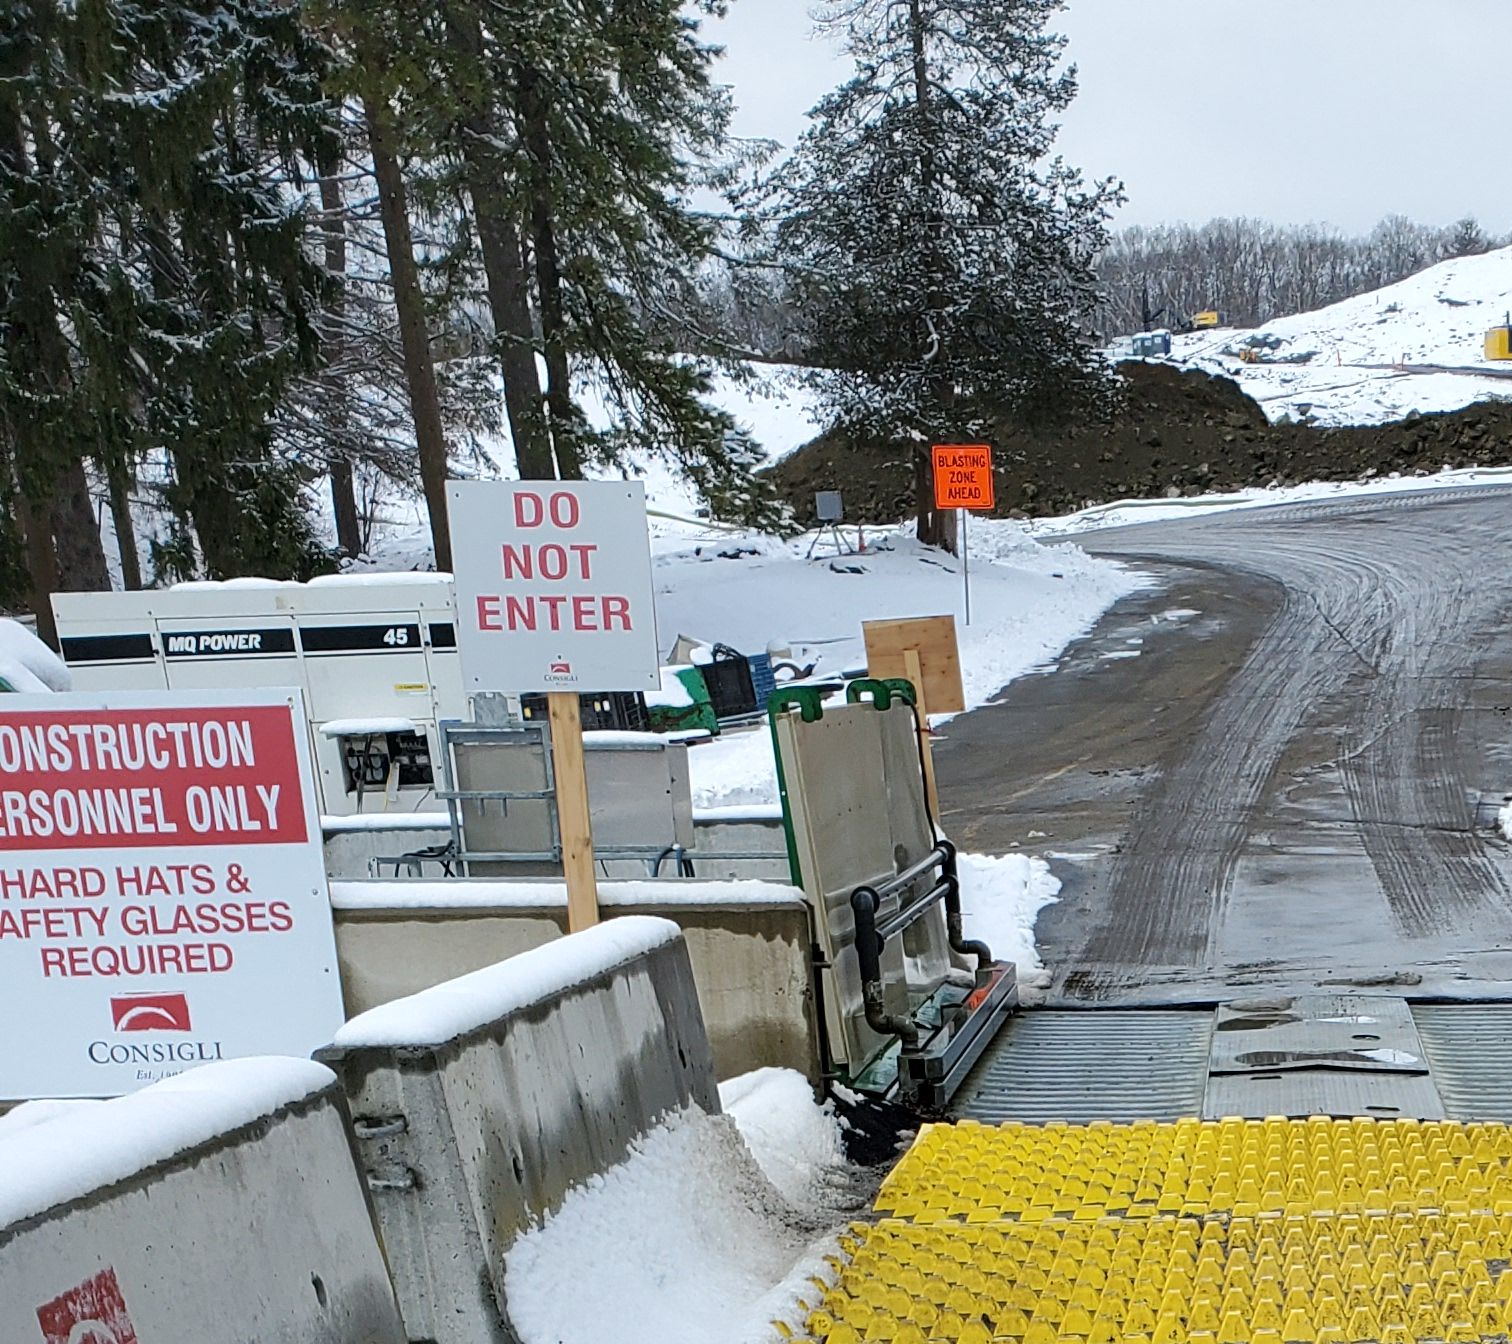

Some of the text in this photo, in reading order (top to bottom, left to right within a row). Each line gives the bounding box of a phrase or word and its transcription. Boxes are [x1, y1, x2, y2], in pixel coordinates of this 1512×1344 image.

[938, 454, 986, 468] BLASTING
[949, 470, 977, 484] ZONE
[513, 491, 580, 529] DO
[948, 486, 981, 500] AHEAD
[502, 544, 598, 581] NOT
[476, 596, 633, 631] ENTER
[168, 627, 408, 654] MQ POWER 45
[0, 720, 256, 773] ONSTRUCTION
[186, 784, 280, 833] ONLY
[0, 862, 253, 899] HARD HATS &
[0, 901, 294, 940] AFETY GLASSES
[41, 942, 234, 978] REQUIRED
[88, 1041, 224, 1065] CONSIGLI
